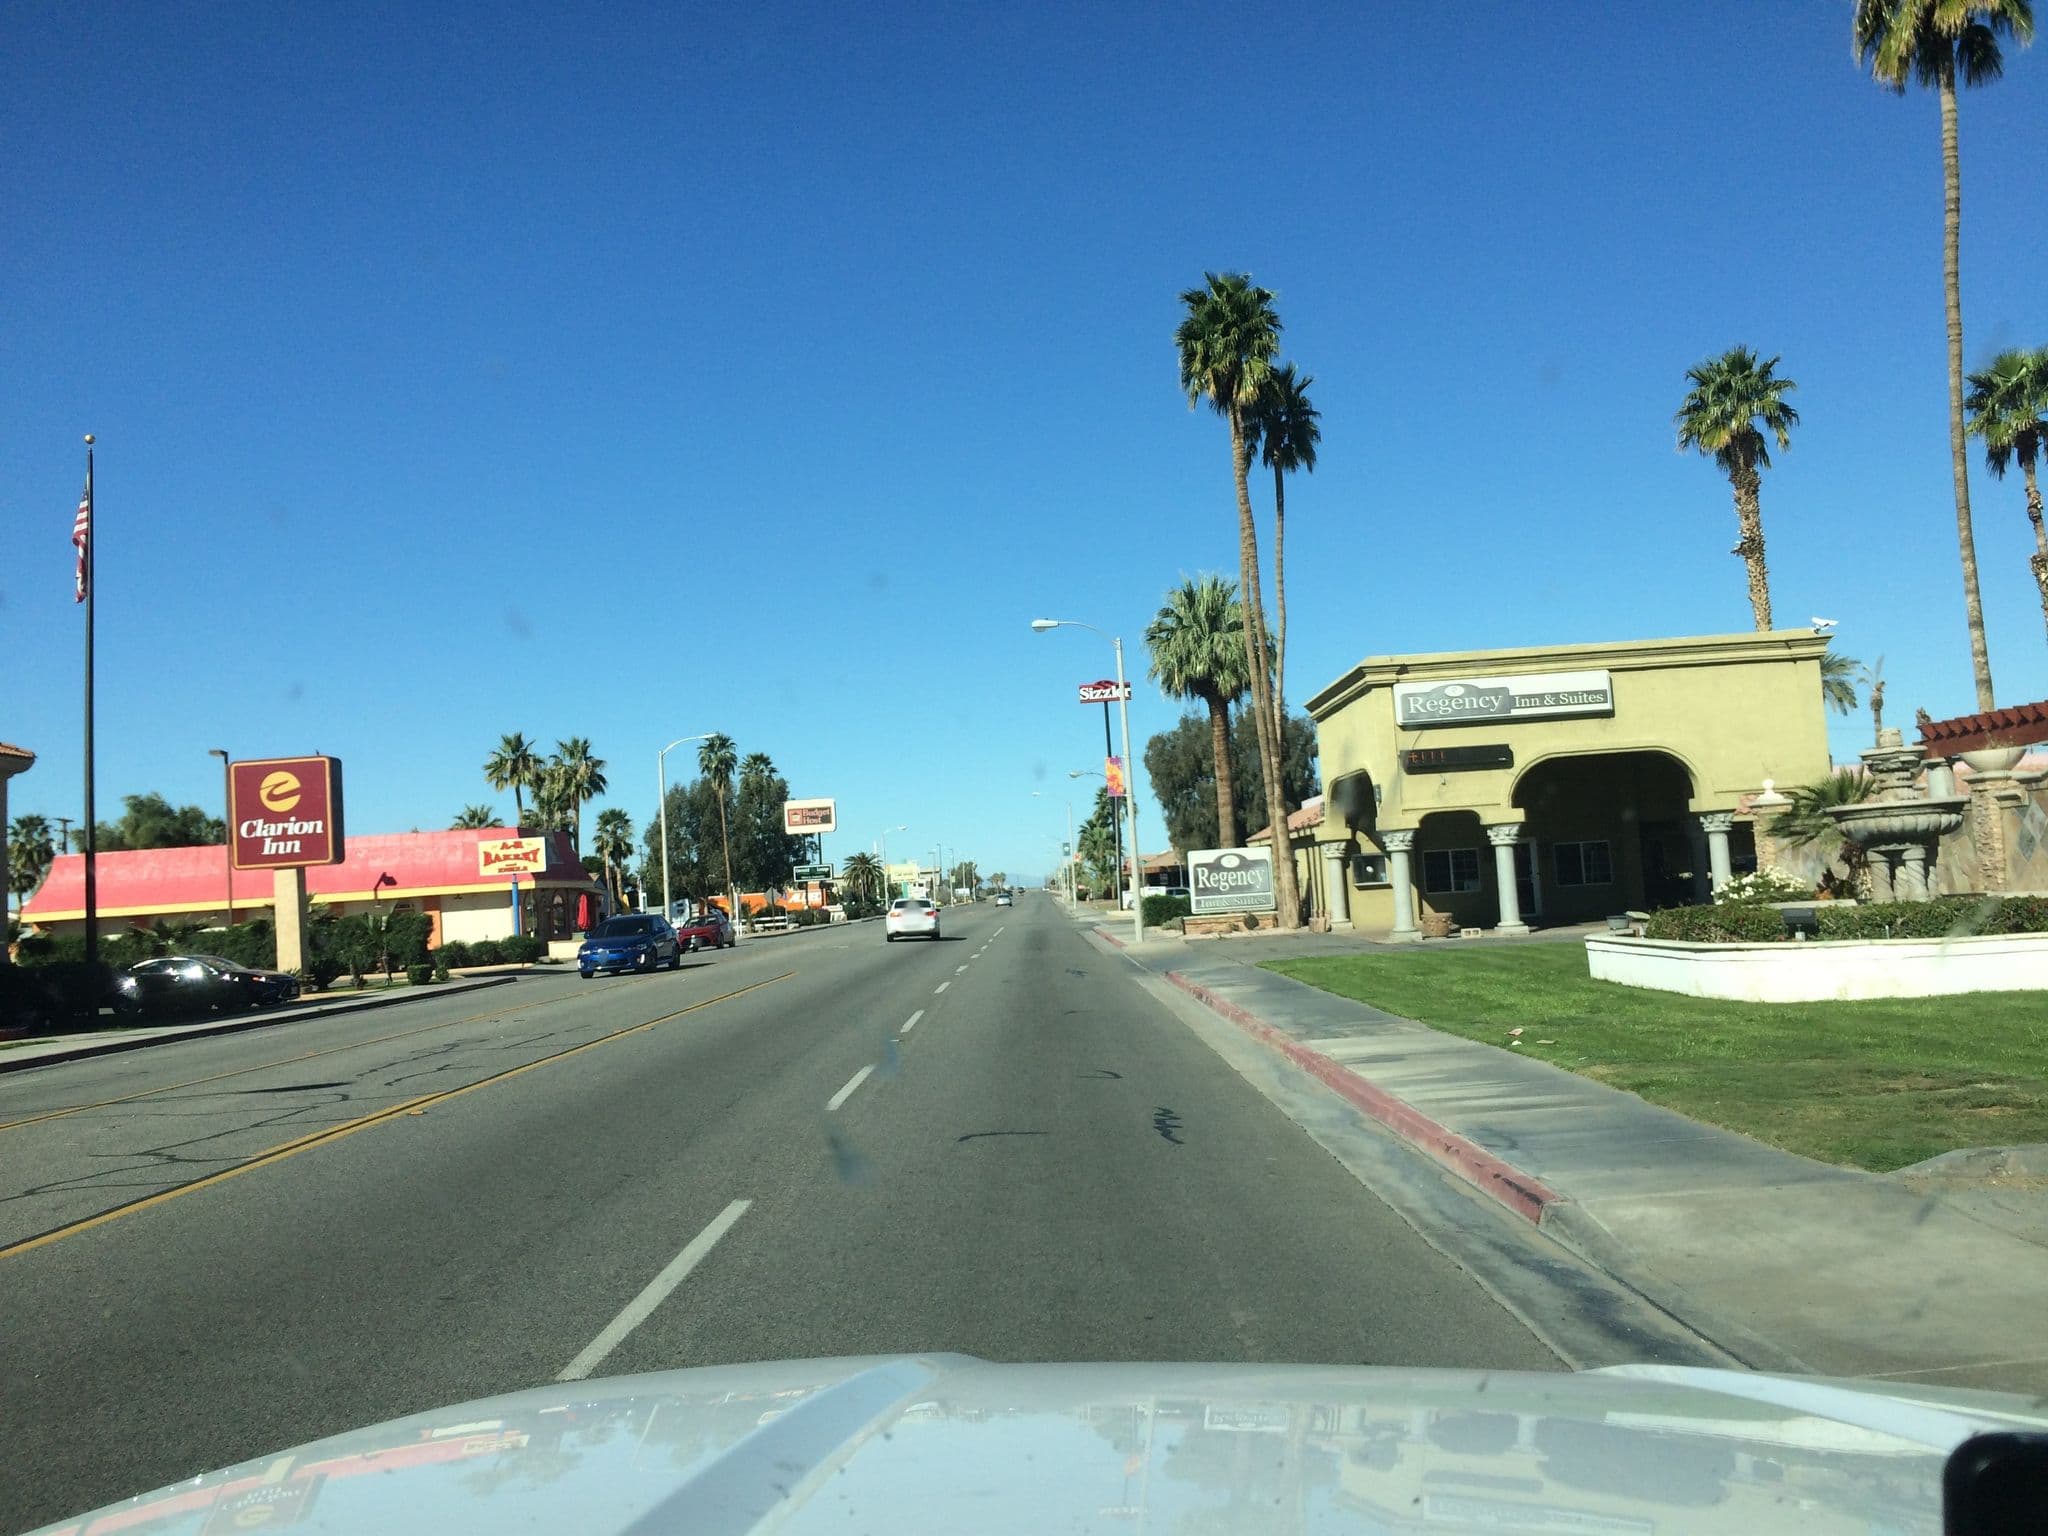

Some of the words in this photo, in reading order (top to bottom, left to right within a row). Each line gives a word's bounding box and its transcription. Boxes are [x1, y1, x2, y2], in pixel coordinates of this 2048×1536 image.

[1408, 693, 1503, 715] Regency
[1514, 695, 1540, 708] Inn
[1544, 694, 1558, 706] &
[1559, 690, 1605, 705] Suites
[803, 808, 830, 818] Budget
[803, 816, 821, 824] Host
[240, 816, 323, 839] Clarion
[261, 837, 301, 855] Inn
[1196, 867, 1266, 892] Regency
[1199, 899, 1220, 908] Inn
[1222, 897, 1232, 907] &
[1234, 895, 1267, 906] Suites
